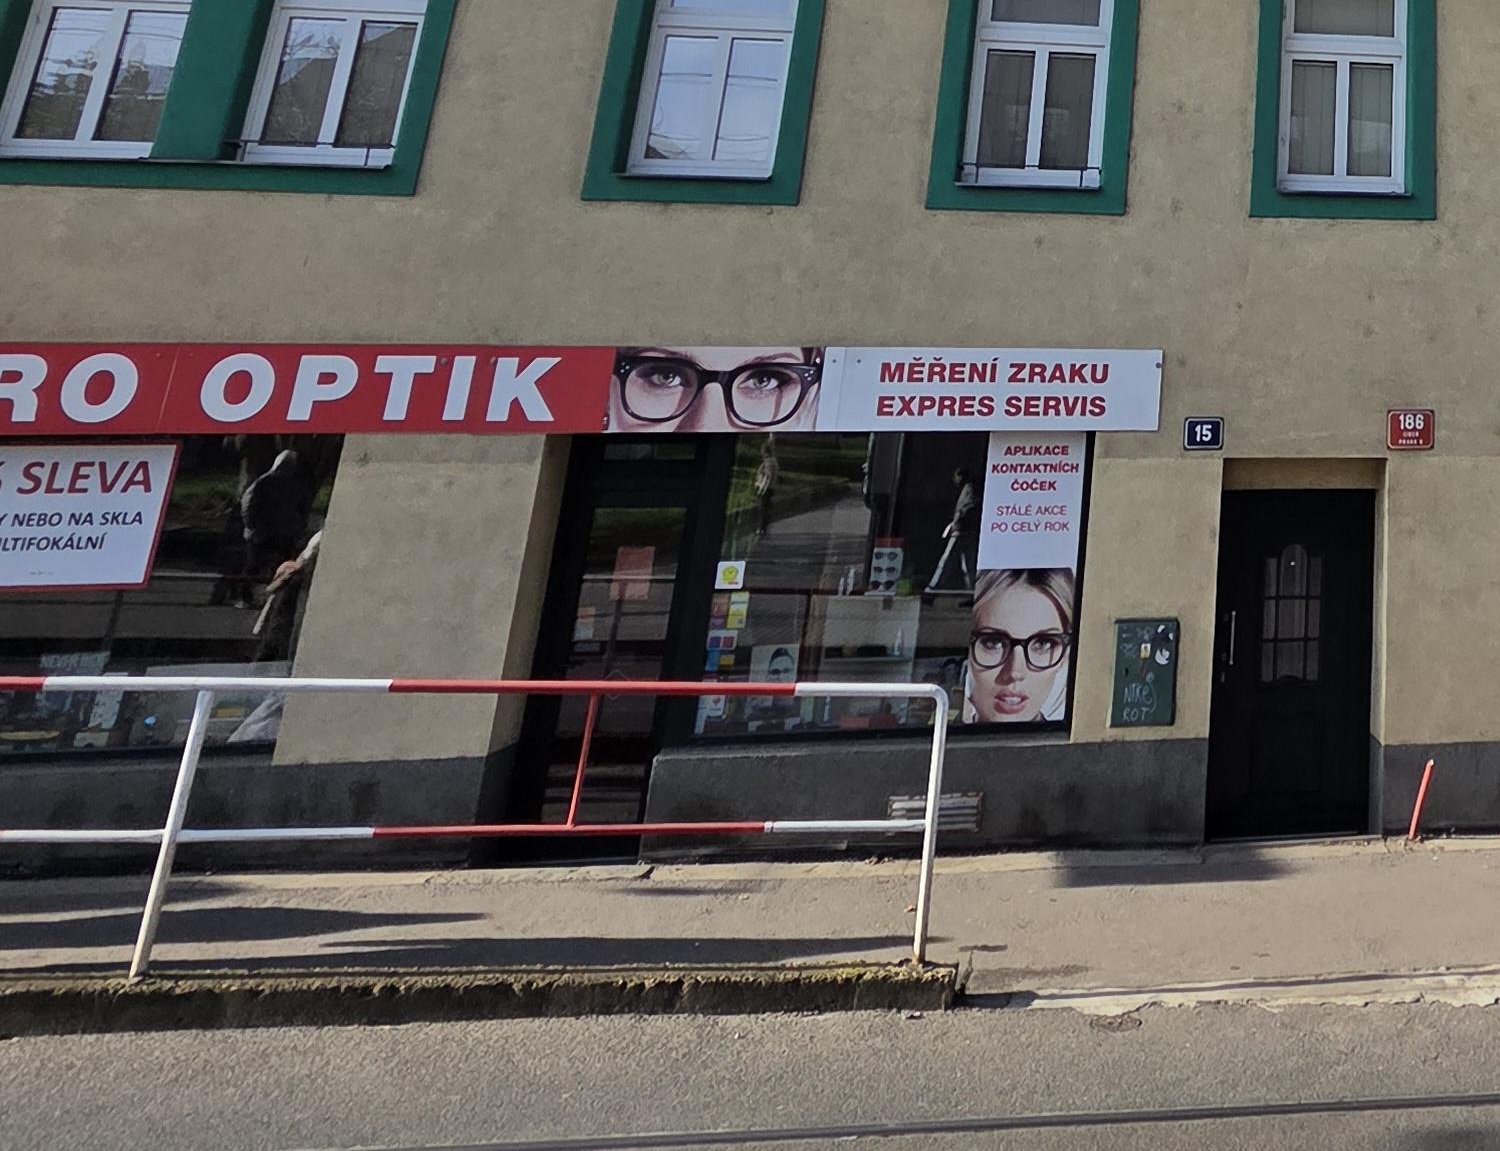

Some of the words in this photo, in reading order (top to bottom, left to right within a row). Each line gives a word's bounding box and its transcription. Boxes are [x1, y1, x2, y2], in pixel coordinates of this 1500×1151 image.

[879, 356, 1000, 383] MĚŘENÍ
[1007, 362, 1110, 384] ZRAKU
[200, 352, 563, 423] OPTIK
[876, 395, 996, 417] EXPRES
[1004, 395, 1107, 417] SERVIS
[1399, 413, 1425, 430] 186
[1194, 424, 1213, 442] 15
[1004, 445, 1070, 456] APLIKACE
[991, 460, 1080, 474] KONTAKTNÍCH
[16, 460, 153, 495] SLEVA
[1010, 478, 1057, 491] ČOČEK
[996, 502, 1033, 516] STÁLÉ
[1035, 505, 1068, 516] AKCE
[11, 512, 63, 527] NEBO
[67, 512, 94, 527] NA
[99, 511, 144, 526] SKLA
[991, 521, 1009, 533] PO
[1011, 519, 1041, 533] CELÝ
[1044, 521, 1070, 533] ROK
